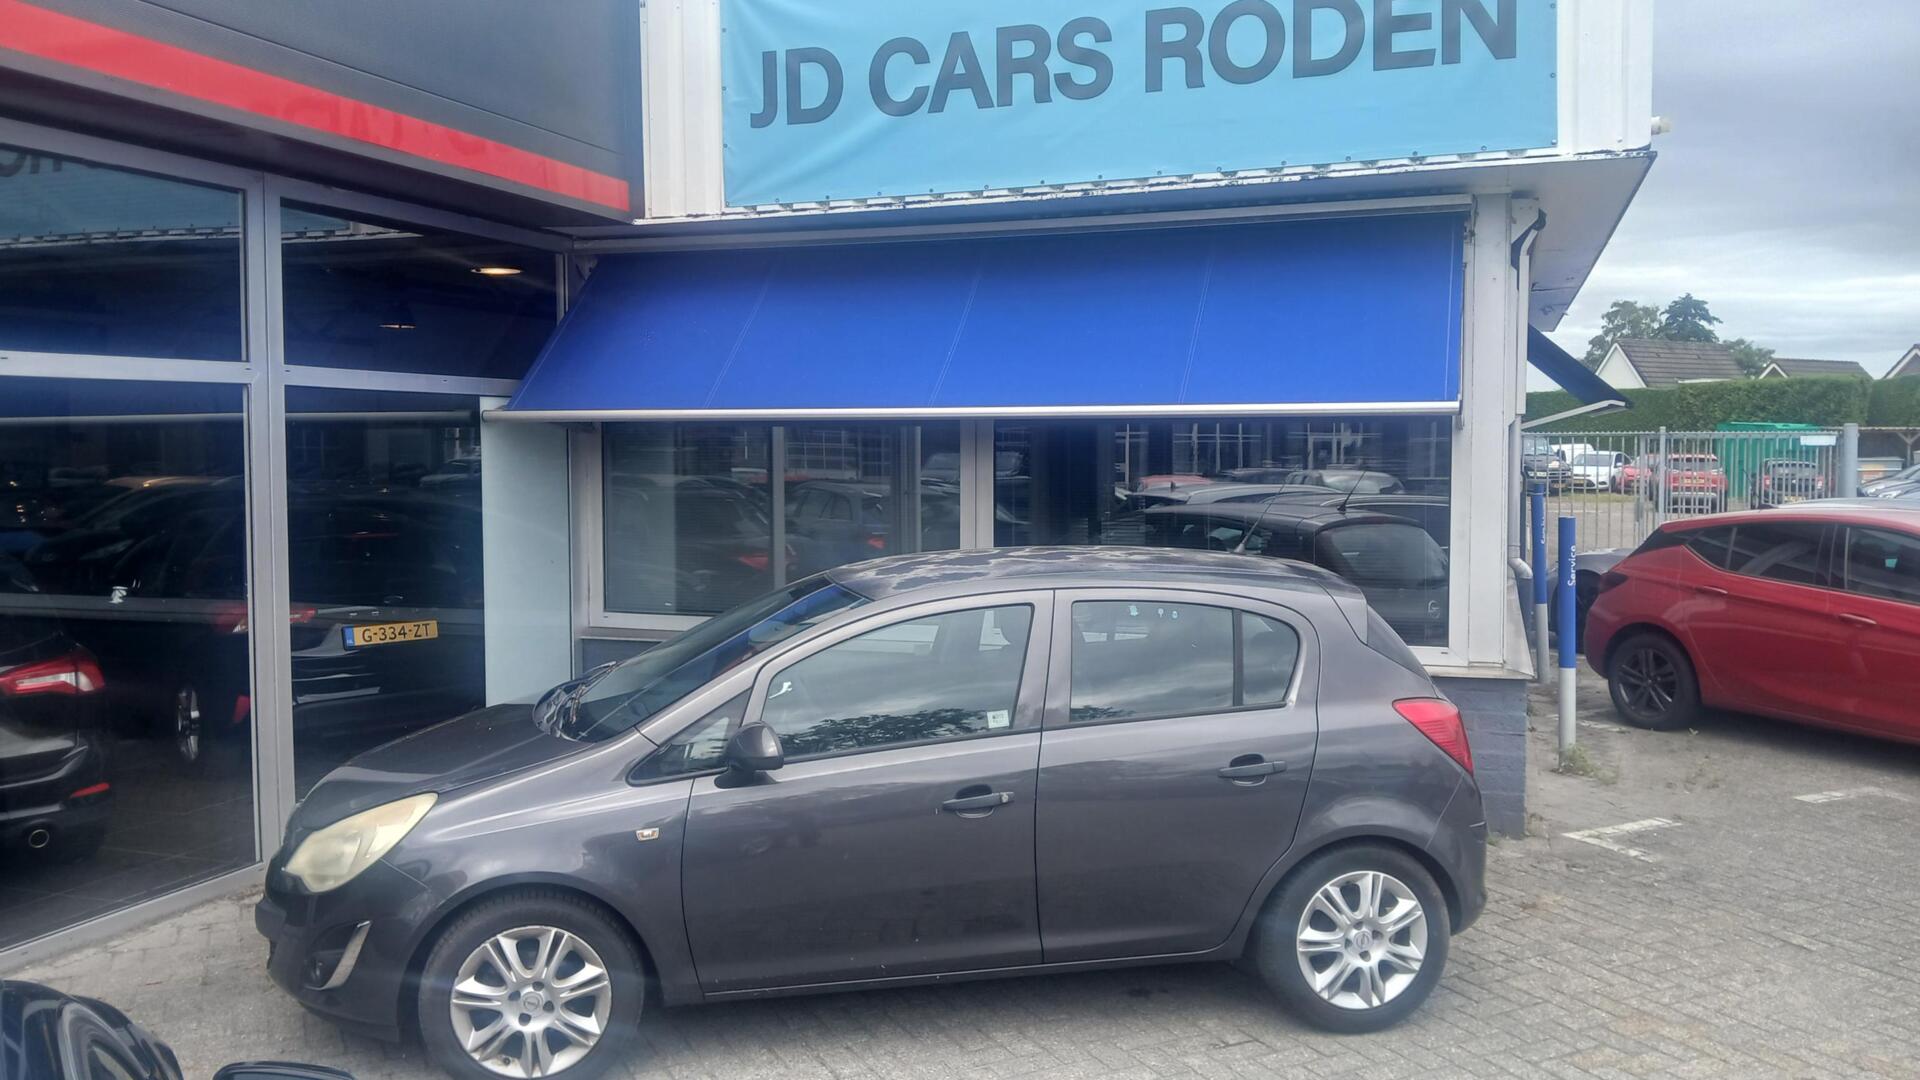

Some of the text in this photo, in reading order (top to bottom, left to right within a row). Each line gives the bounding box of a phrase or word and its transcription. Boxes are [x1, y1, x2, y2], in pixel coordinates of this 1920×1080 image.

[750, 0, 1518, 129] JD CARS RODEN
[1567, 545, 1576, 587] Service
[362, 623, 430, 642] G-334-ZT
